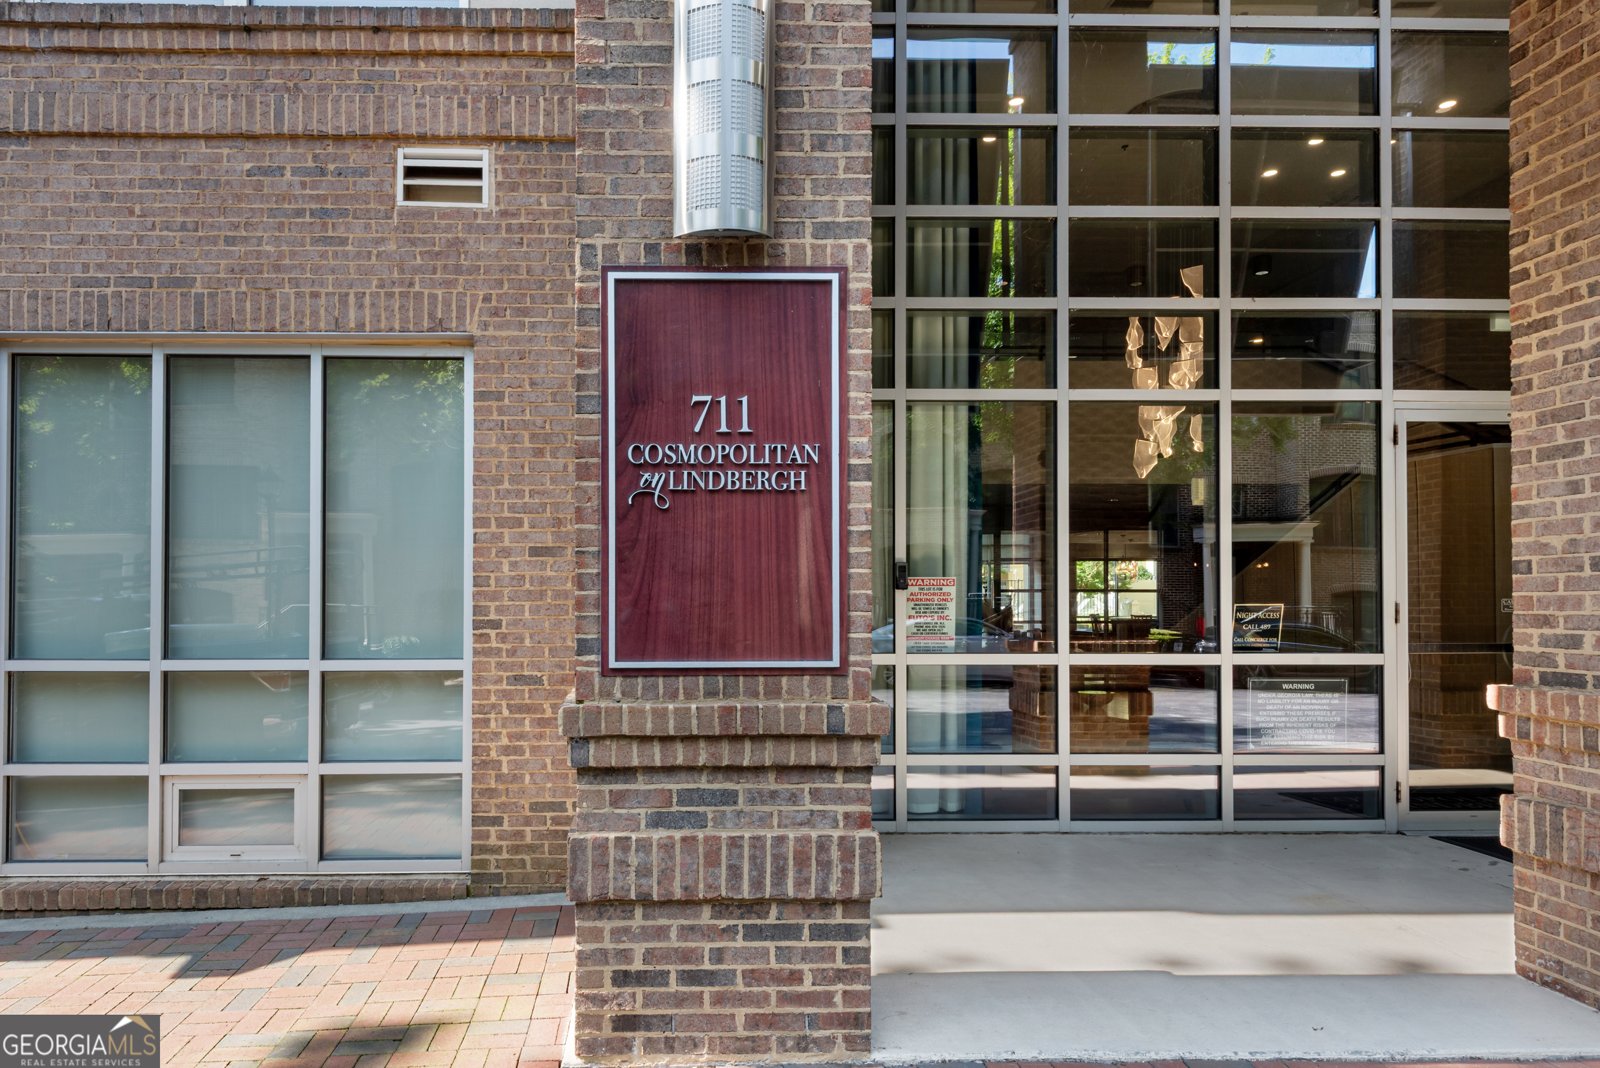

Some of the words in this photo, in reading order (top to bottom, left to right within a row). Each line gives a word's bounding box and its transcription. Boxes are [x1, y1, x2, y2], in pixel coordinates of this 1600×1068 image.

[691, 395, 753, 433] 711
[627, 443, 820, 464] COSMOPOLITAN
[628, 471, 670, 509] on
[668, 470, 807, 490] LINDBERGH
